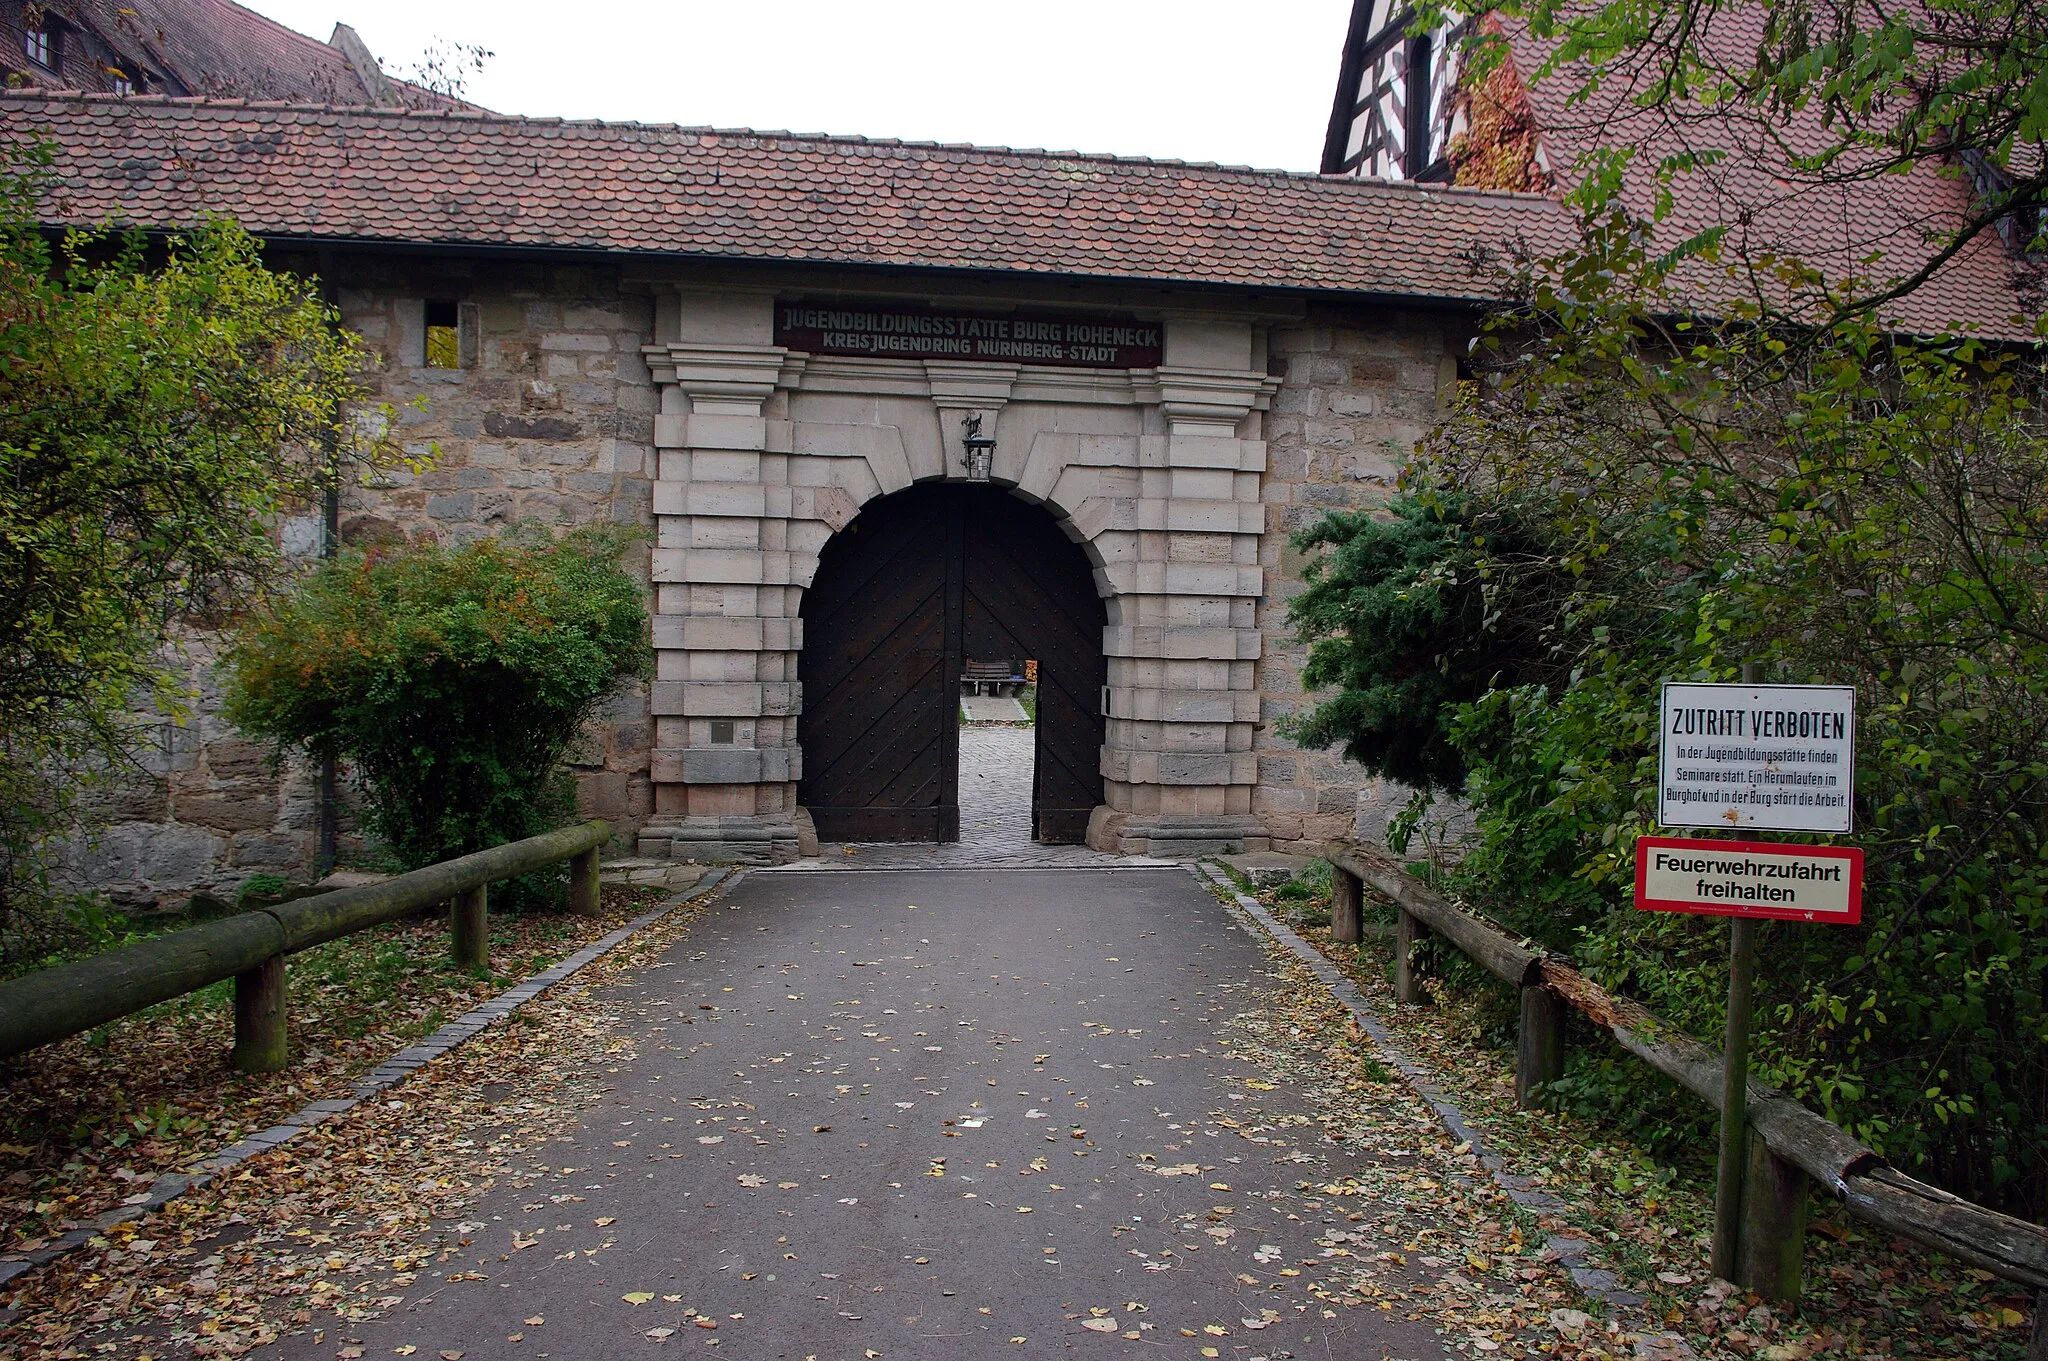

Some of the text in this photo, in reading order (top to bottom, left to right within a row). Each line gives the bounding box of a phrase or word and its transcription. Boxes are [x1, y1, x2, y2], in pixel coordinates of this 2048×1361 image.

[783, 308, 1158, 348] JUGENDBILDUNGSSTÄTTE BURG HOHENECK
[823, 332, 1118, 362] KREISJUGENDRING NÜRNBERG-STADT
[1672, 708, 1845, 740] ZUTRITT VERBOTEN
[1677, 745, 1838, 764] In der Jugendbildungsstätte finden
[1677, 767, 1837, 786] Seminare statt. Ein Herumlaufen im
[1666, 787, 1847, 808] Burghof und in der Burg stört die Arbeit.
[1655, 853, 1841, 882] Feuerwehrzufahrt
[1696, 879, 1796, 902] freihalten
